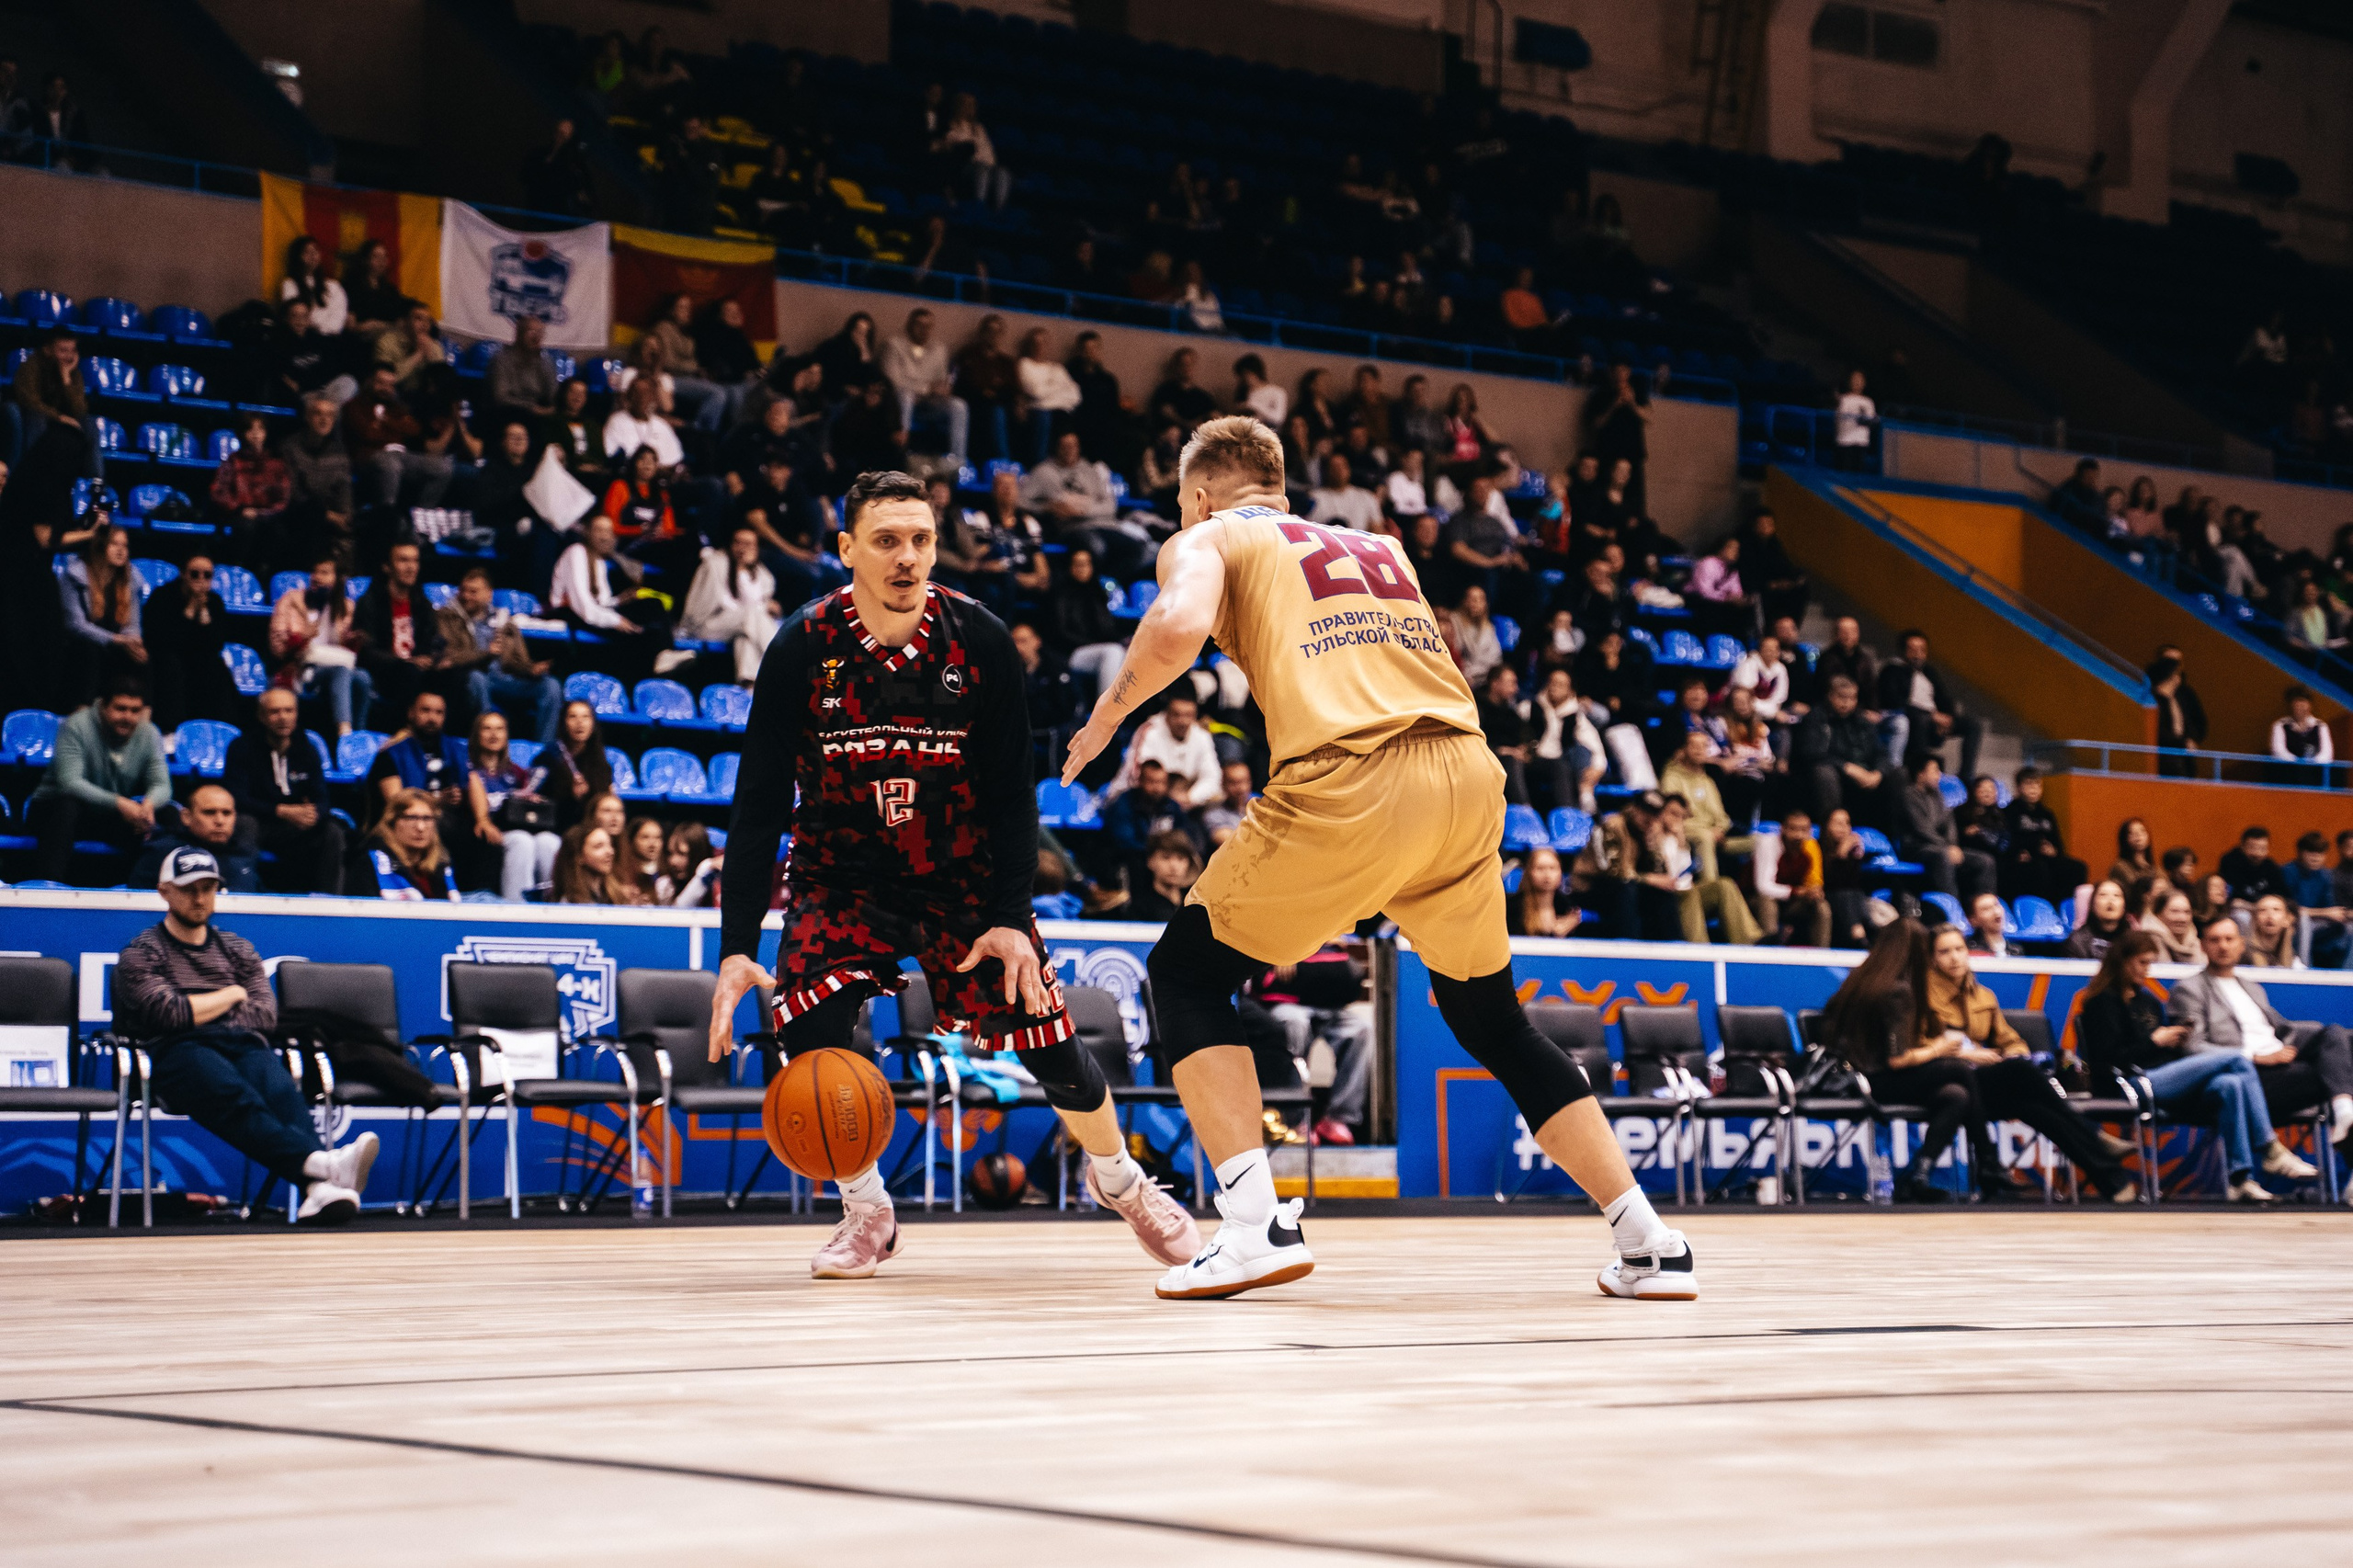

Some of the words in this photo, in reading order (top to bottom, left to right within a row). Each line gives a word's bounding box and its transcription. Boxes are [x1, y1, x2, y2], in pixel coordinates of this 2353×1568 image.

[1277, 522, 1421, 604] 28
[1300, 626, 1391, 658] ТУЛЬСКОЙ
[822, 739, 962, 764] РЯЗАНЬ
[870, 778, 916, 827] 12
